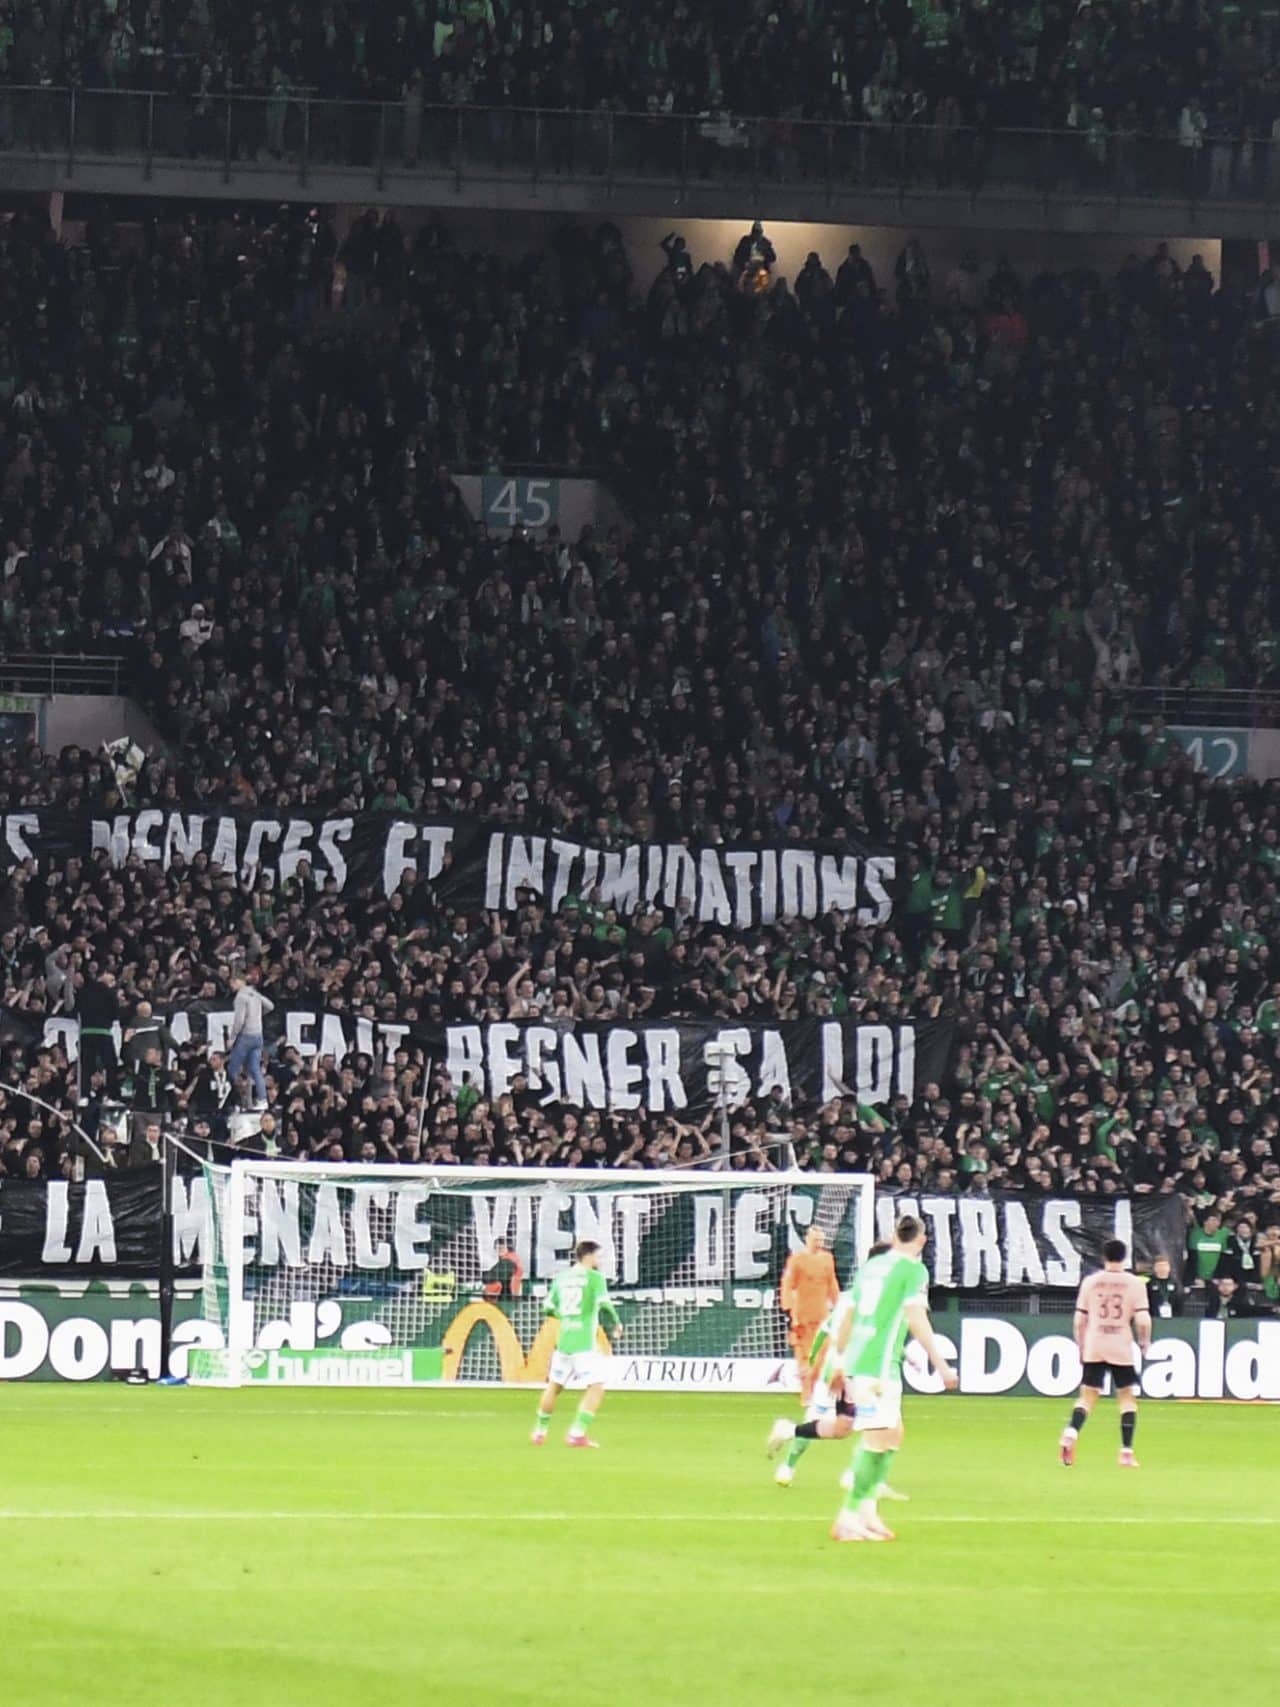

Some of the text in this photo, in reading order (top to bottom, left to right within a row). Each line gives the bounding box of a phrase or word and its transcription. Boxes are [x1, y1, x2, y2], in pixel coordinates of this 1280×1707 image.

[489, 480, 551, 527] 45
[383, 821, 454, 899] ET
[485, 832, 896, 929] INTIMIDATIONS
[446, 1022, 687, 1112] REGNER
[822, 1022, 915, 1107] LOI
[41, 1179, 118, 1264] LA
[472, 1194, 650, 1284] VIENT
[1098, 1293, 1124, 1320] 33
[272, 1351, 412, 1382] hummel
[622, 1360, 736, 1383] ATRIUM
